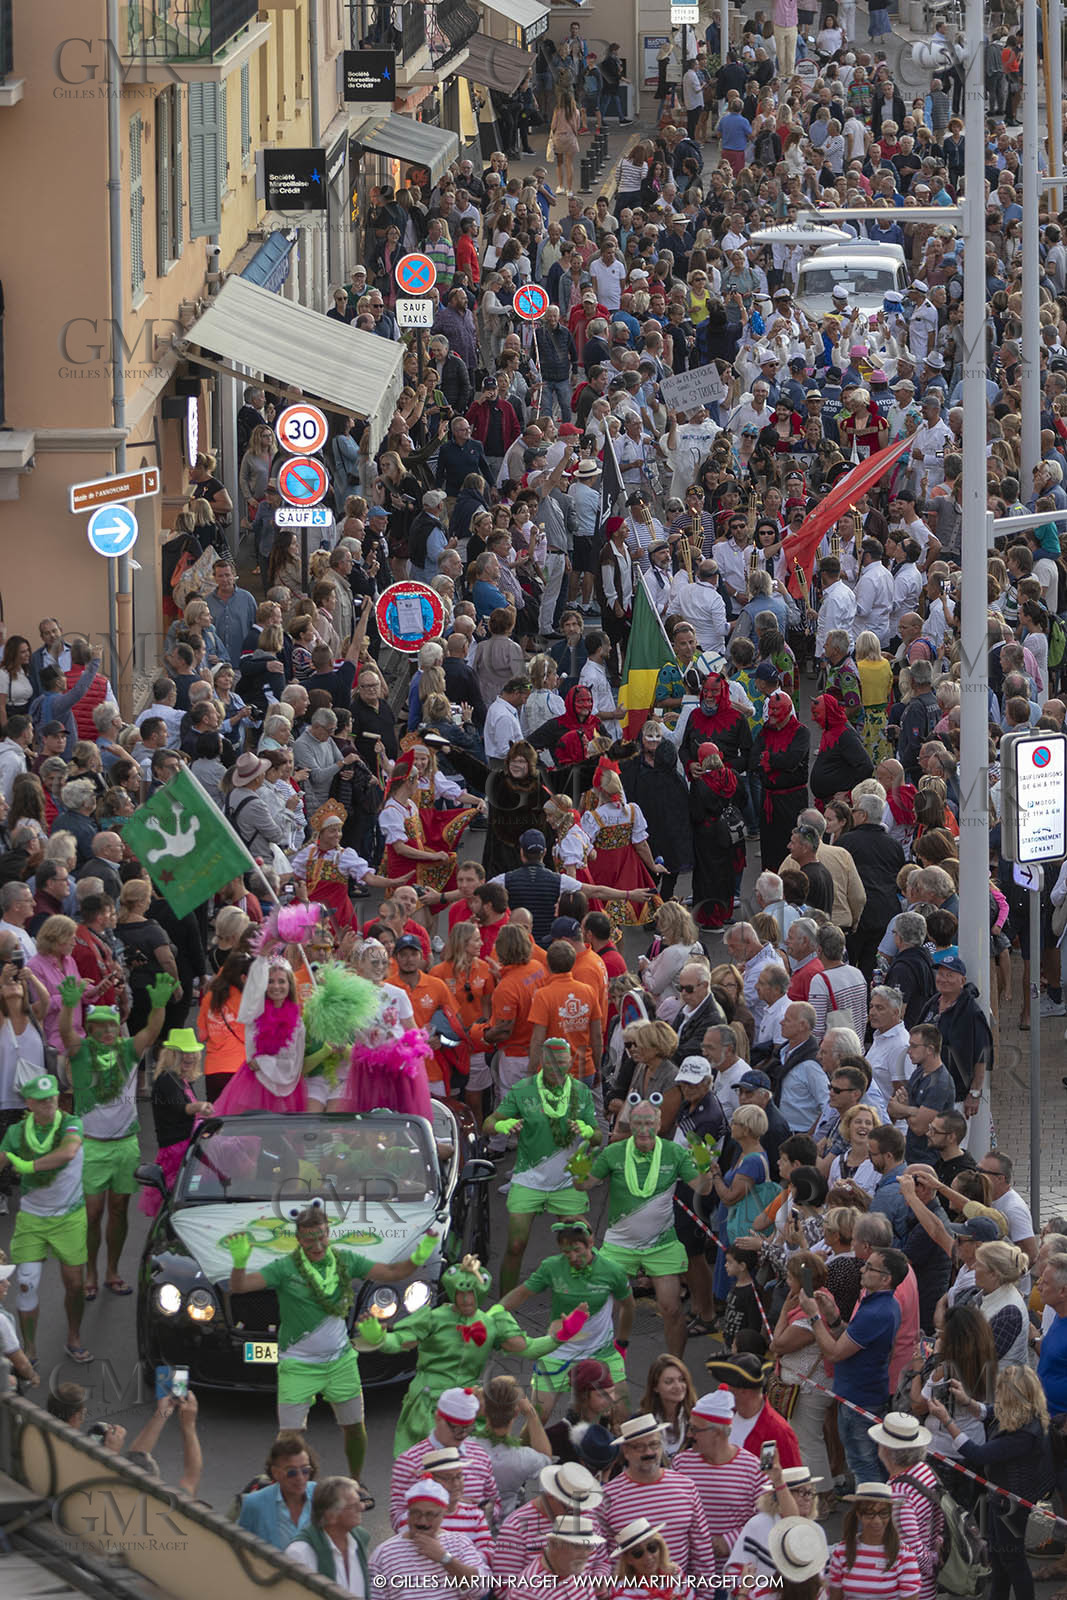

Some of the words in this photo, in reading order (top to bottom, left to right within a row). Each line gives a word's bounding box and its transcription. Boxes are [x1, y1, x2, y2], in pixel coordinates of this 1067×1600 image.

[403, 303, 426, 311] SAUF
[403, 315, 428, 323] TAXIS
[289, 420, 317, 440] 30
[279, 513, 310, 522] SAUF
